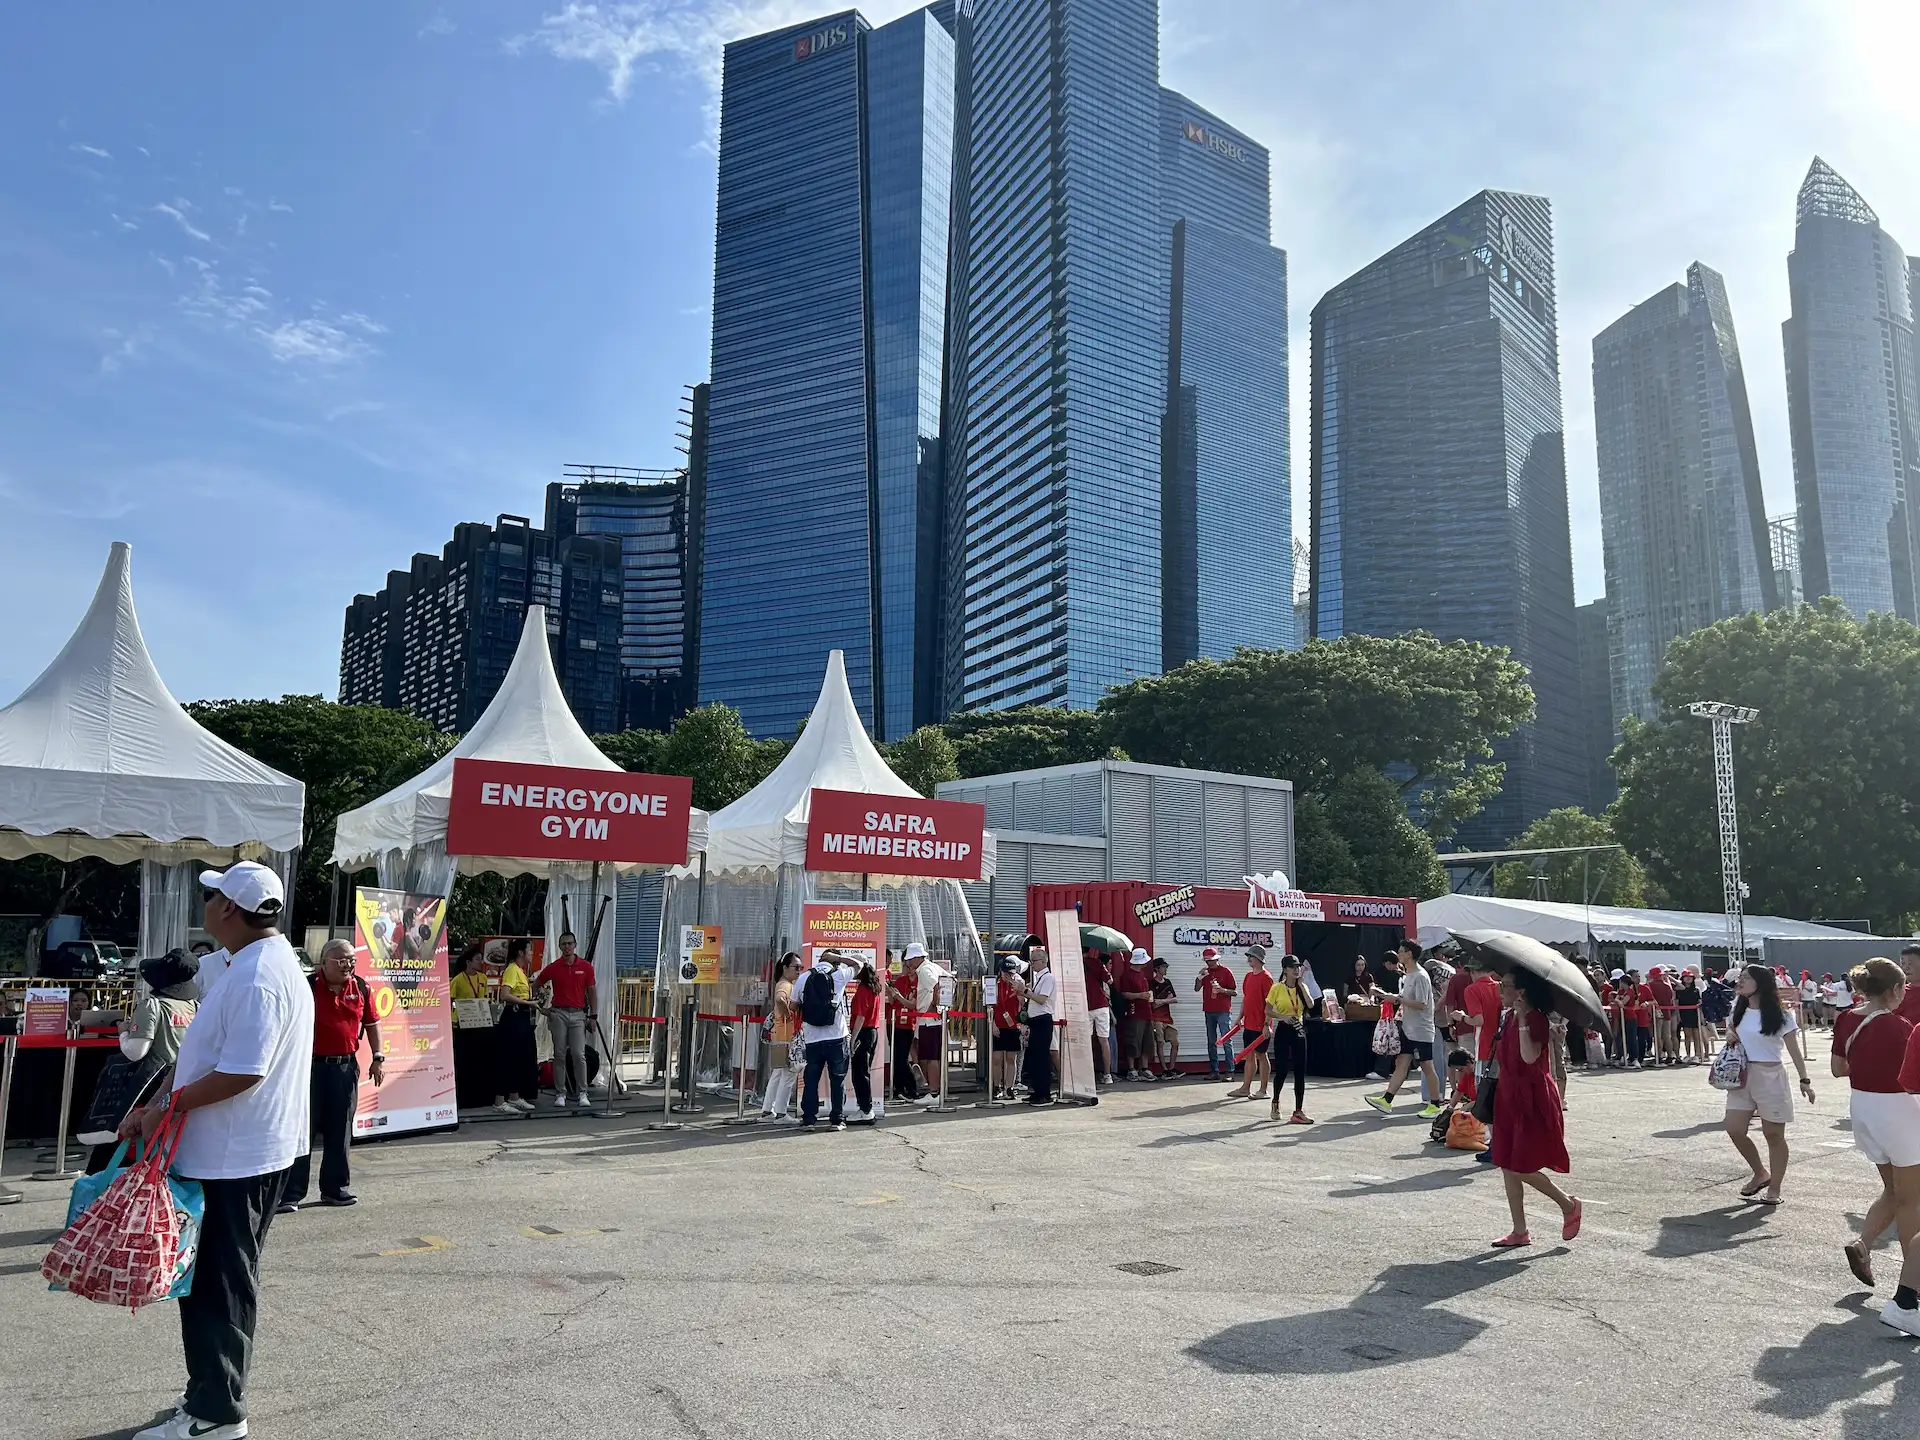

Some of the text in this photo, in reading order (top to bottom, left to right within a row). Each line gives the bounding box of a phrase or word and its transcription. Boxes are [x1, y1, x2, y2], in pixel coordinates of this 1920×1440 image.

[811, 23, 847, 54] DBS
[1208, 132, 1246, 163] HSBC
[481, 782, 667, 817] ENERGYONE
[541, 816, 609, 841] GYM
[863, 811, 937, 836] SAFRA
[823, 833, 971, 861] MEMBERSHIP
[1134, 885, 1195, 917] #CELEBRATE
[1278, 890, 1305, 900] SAFRA
[1279, 900, 1320, 910] BAYFRONT
[1337, 901, 1404, 918] PHOTOBOOTH
[827, 910, 863, 921] SAFRA
[809, 920, 881, 931] MEMBERSHIP
[823, 930, 867, 938] ROADSHOWS
[369, 959, 437, 969] 2 DAYS PROMO!
[396, 988, 429, 998] JOINING
[396, 998, 441, 1008] ADMIN FEE
[411, 1037, 431, 1052] $50
[435, 1109, 453, 1117] SAFRA
